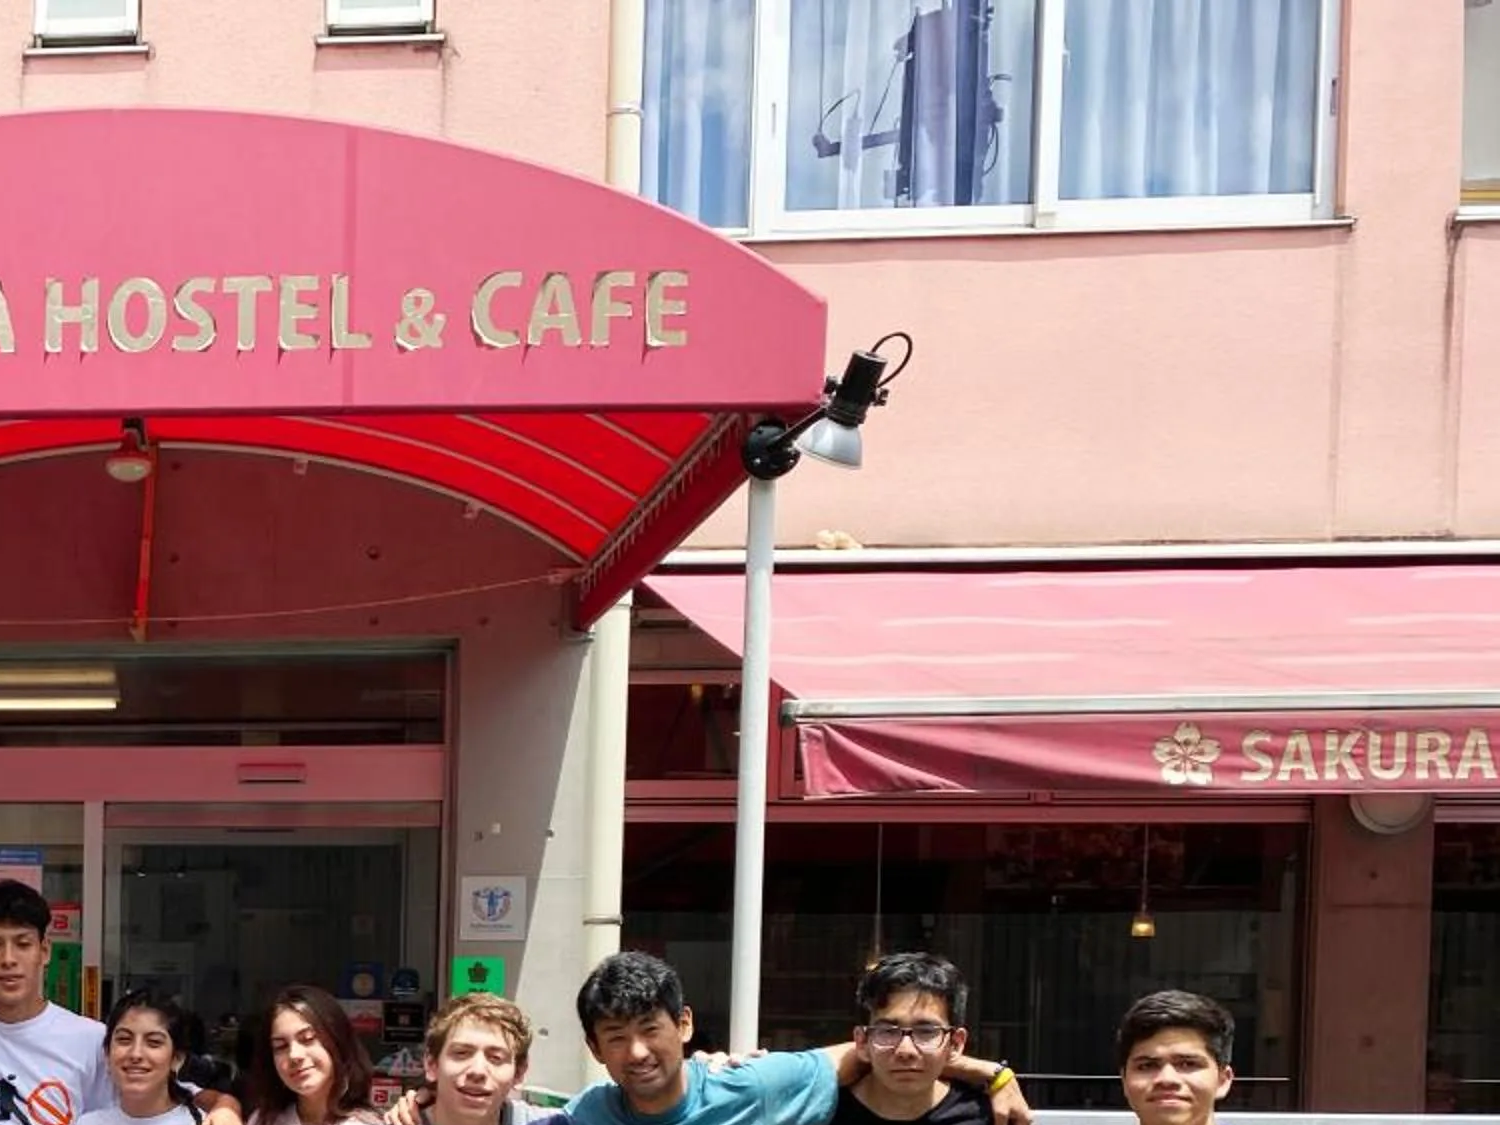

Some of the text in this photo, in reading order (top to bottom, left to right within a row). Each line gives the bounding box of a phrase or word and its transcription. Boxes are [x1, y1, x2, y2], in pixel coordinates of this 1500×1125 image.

[45, 274, 372, 353] HOSTEL
[394, 287, 446, 350] &
[470, 271, 688, 349] CAFE
[1240, 728, 1498, 782] SAKURA
